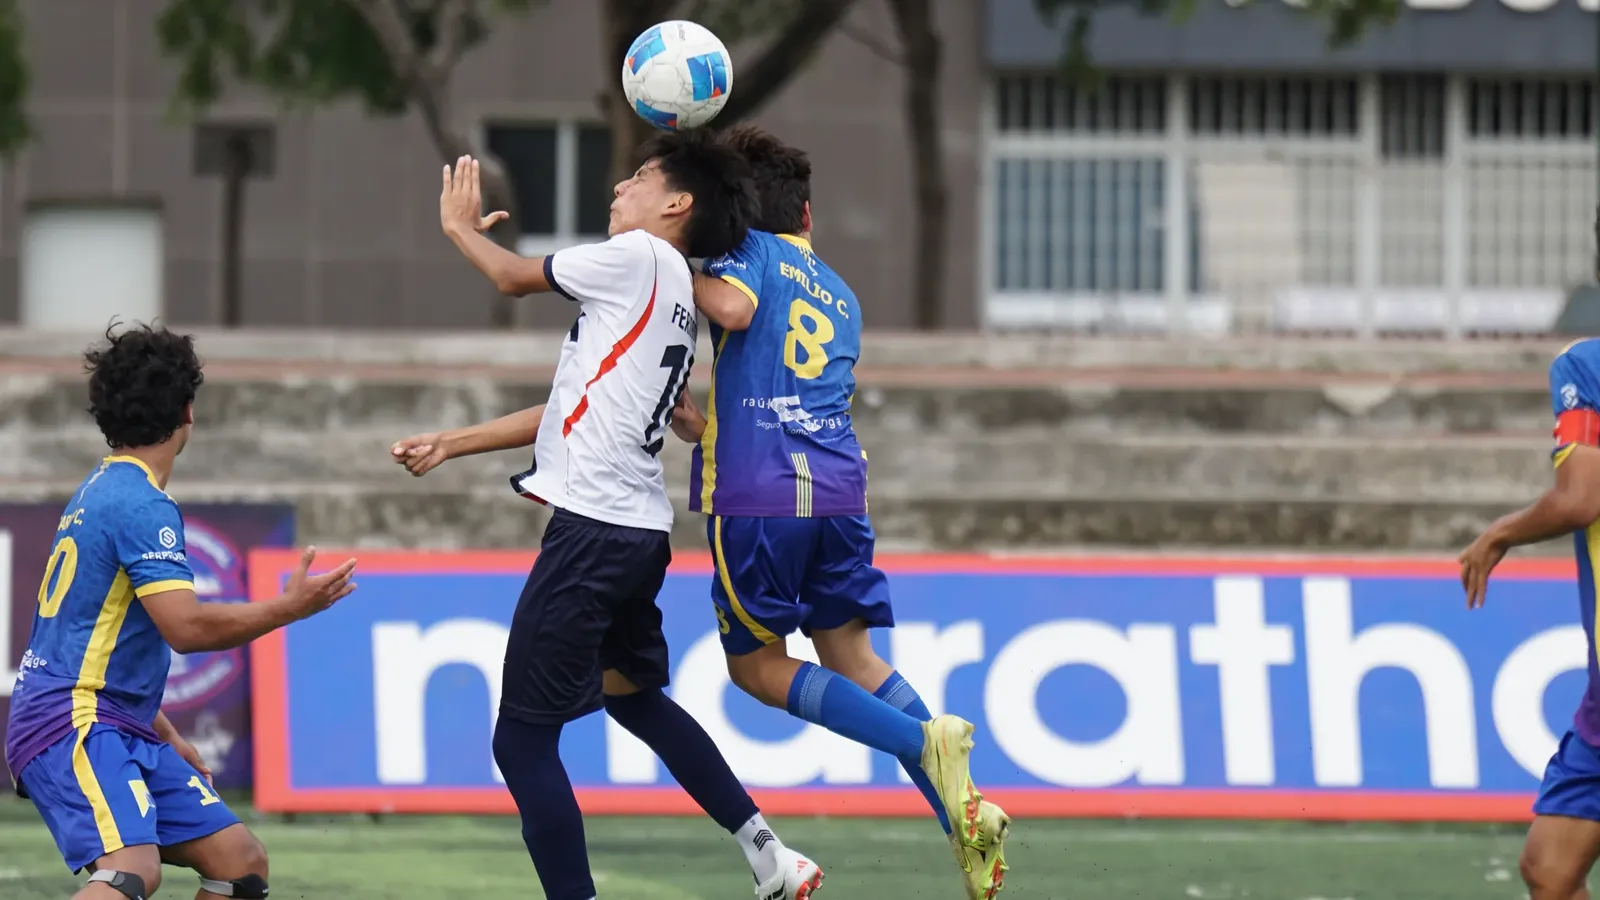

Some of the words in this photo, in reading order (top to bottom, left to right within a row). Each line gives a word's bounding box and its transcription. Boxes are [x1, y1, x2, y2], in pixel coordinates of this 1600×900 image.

[779, 261, 833, 305] EMILIO
[836, 299, 849, 319] C.
[783, 298, 835, 379] 8
